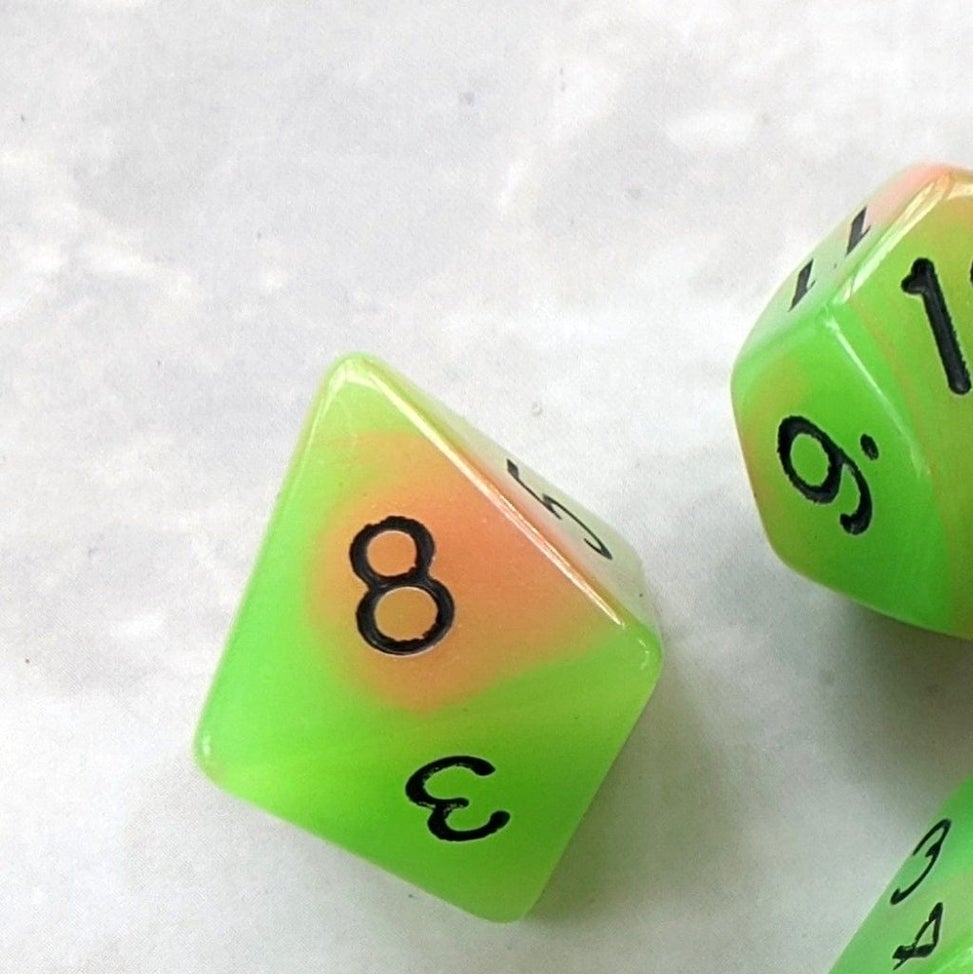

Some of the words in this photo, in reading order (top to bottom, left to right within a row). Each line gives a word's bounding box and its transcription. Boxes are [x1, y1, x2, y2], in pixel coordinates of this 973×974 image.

[349, 516, 455, 656] 8
[405, 755, 511, 842] 3
[892, 902, 943, 970] 4
